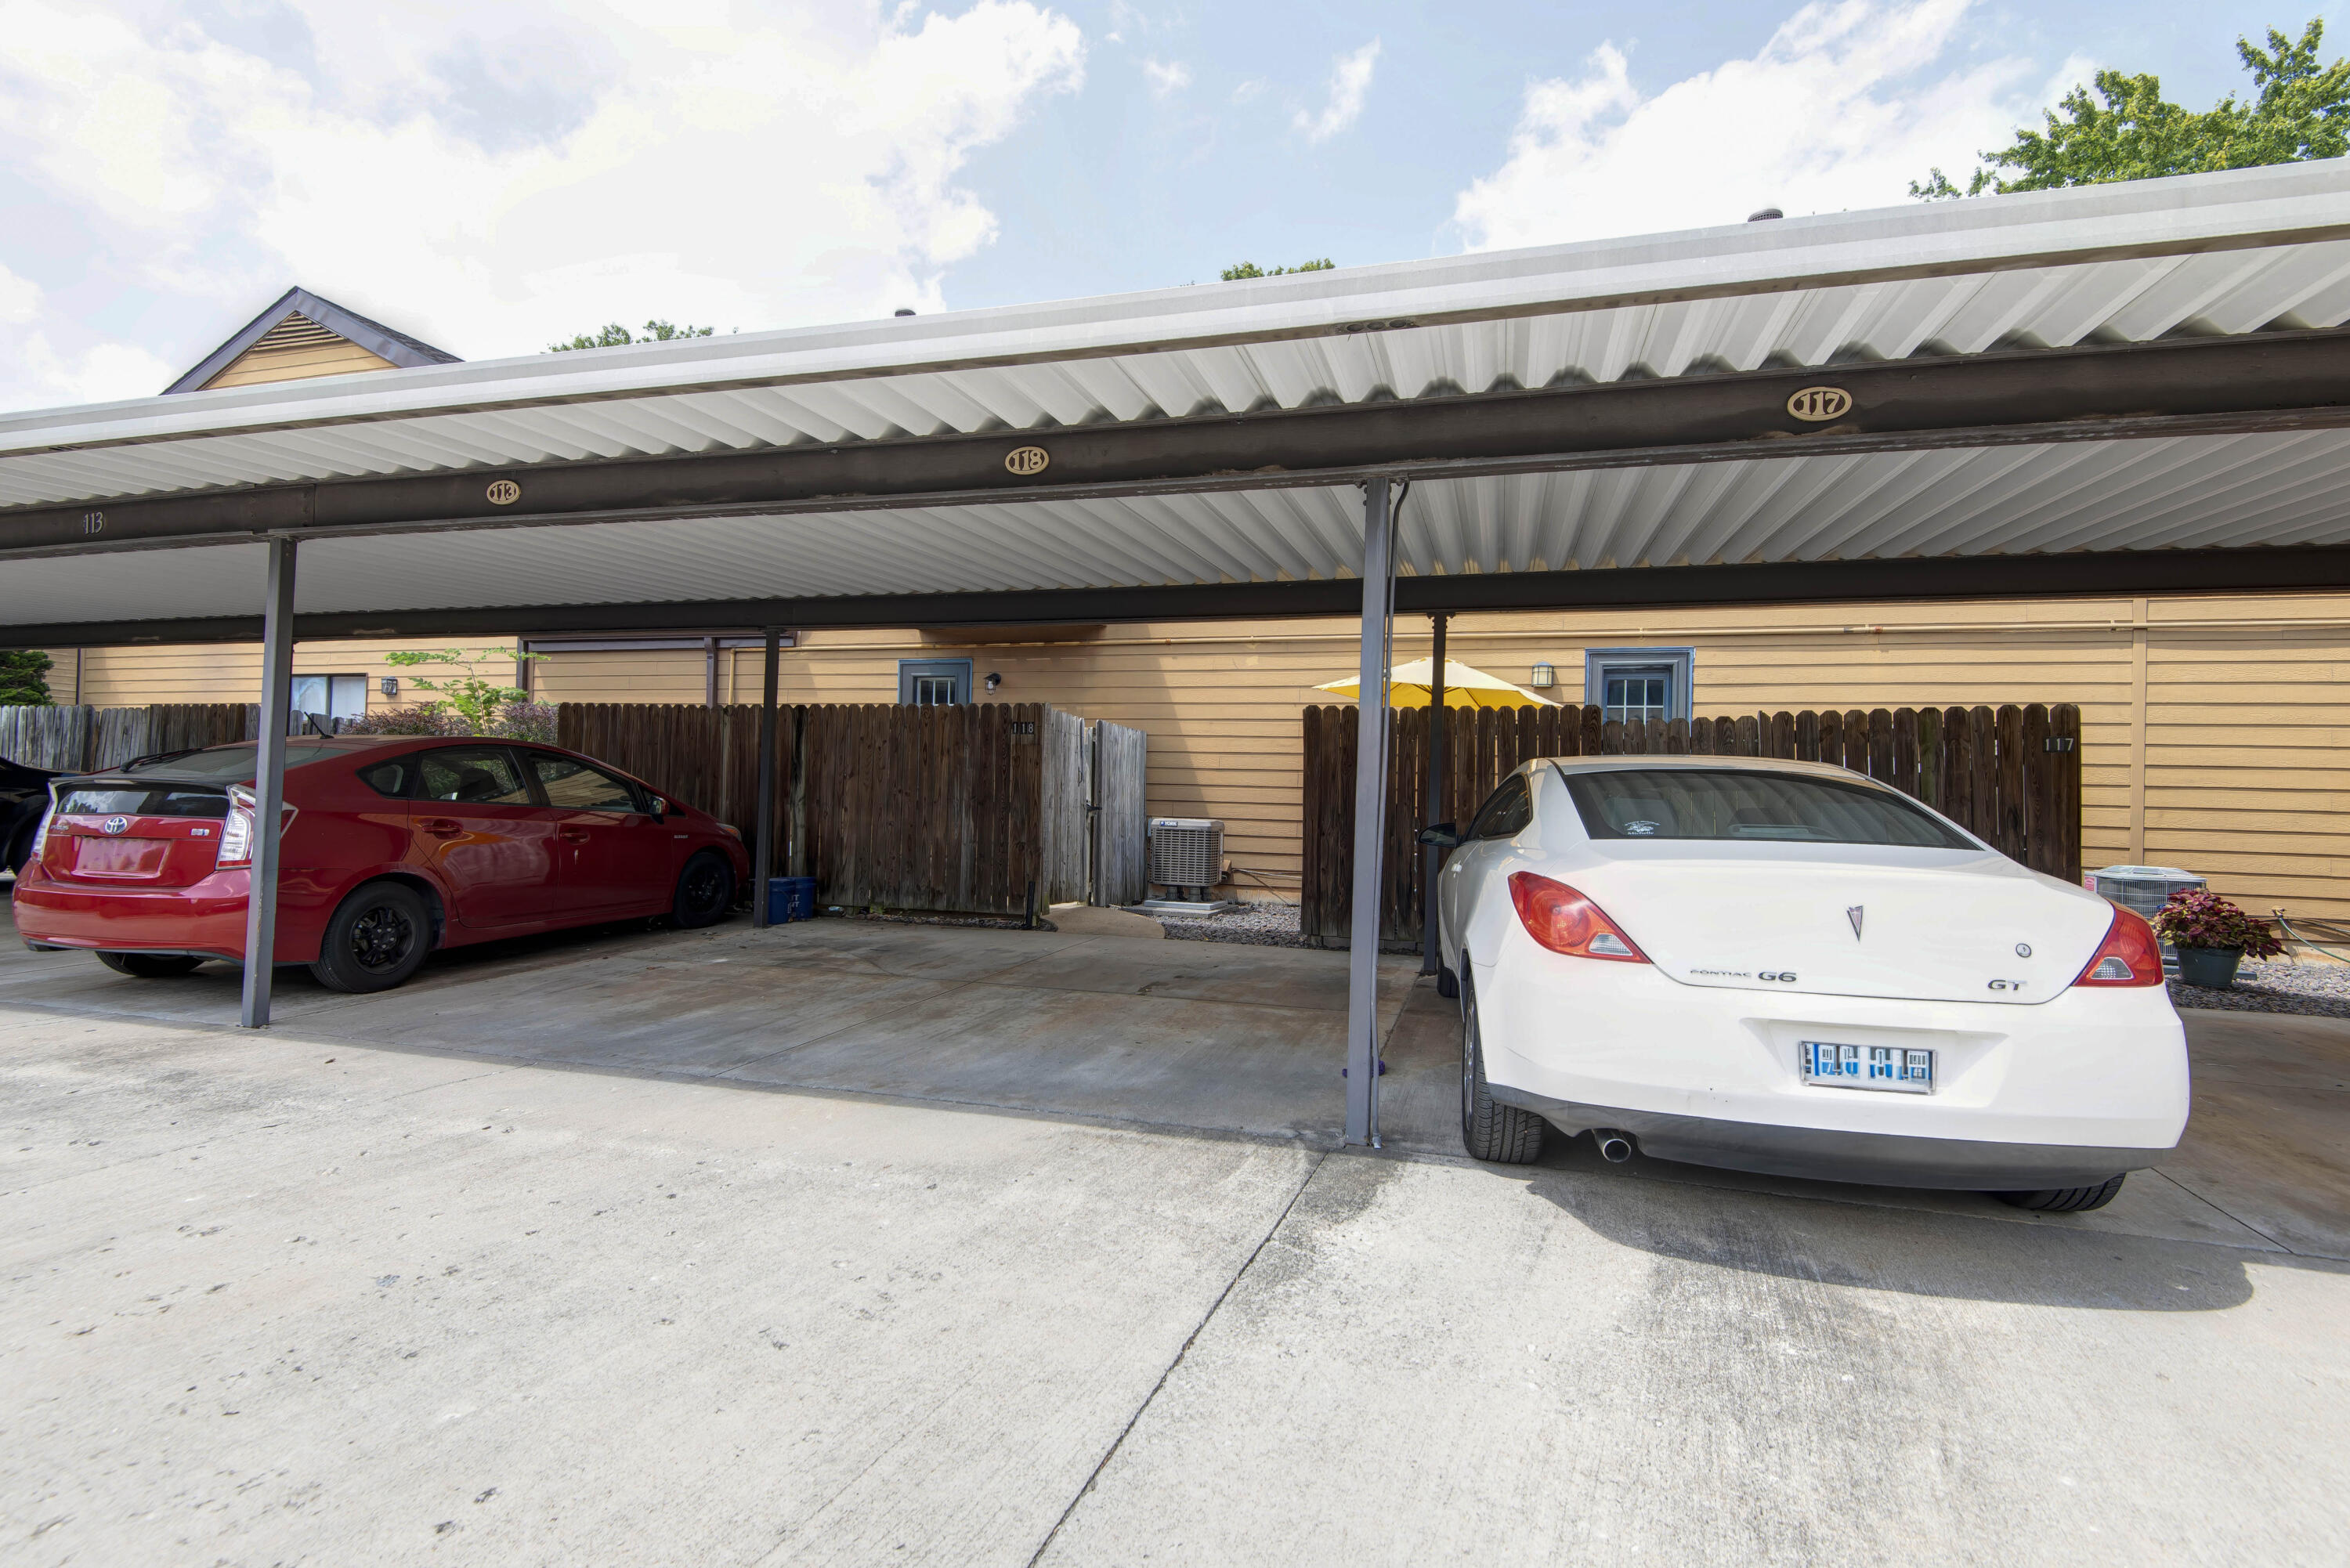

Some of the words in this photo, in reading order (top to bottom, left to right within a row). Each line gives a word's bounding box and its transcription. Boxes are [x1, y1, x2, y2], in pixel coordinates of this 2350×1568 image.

[1799, 392, 1840, 416] 117
[1012, 450, 1043, 471] 118
[493, 483, 515, 501] 113
[84, 511, 103, 534] 113
[1014, 723, 1034, 733] 118
[2045, 738, 2074, 751] 117
[1690, 969, 1752, 977] PONTIAC
[1758, 971, 1797, 982] G6
[1987, 979, 2027, 991] GT
